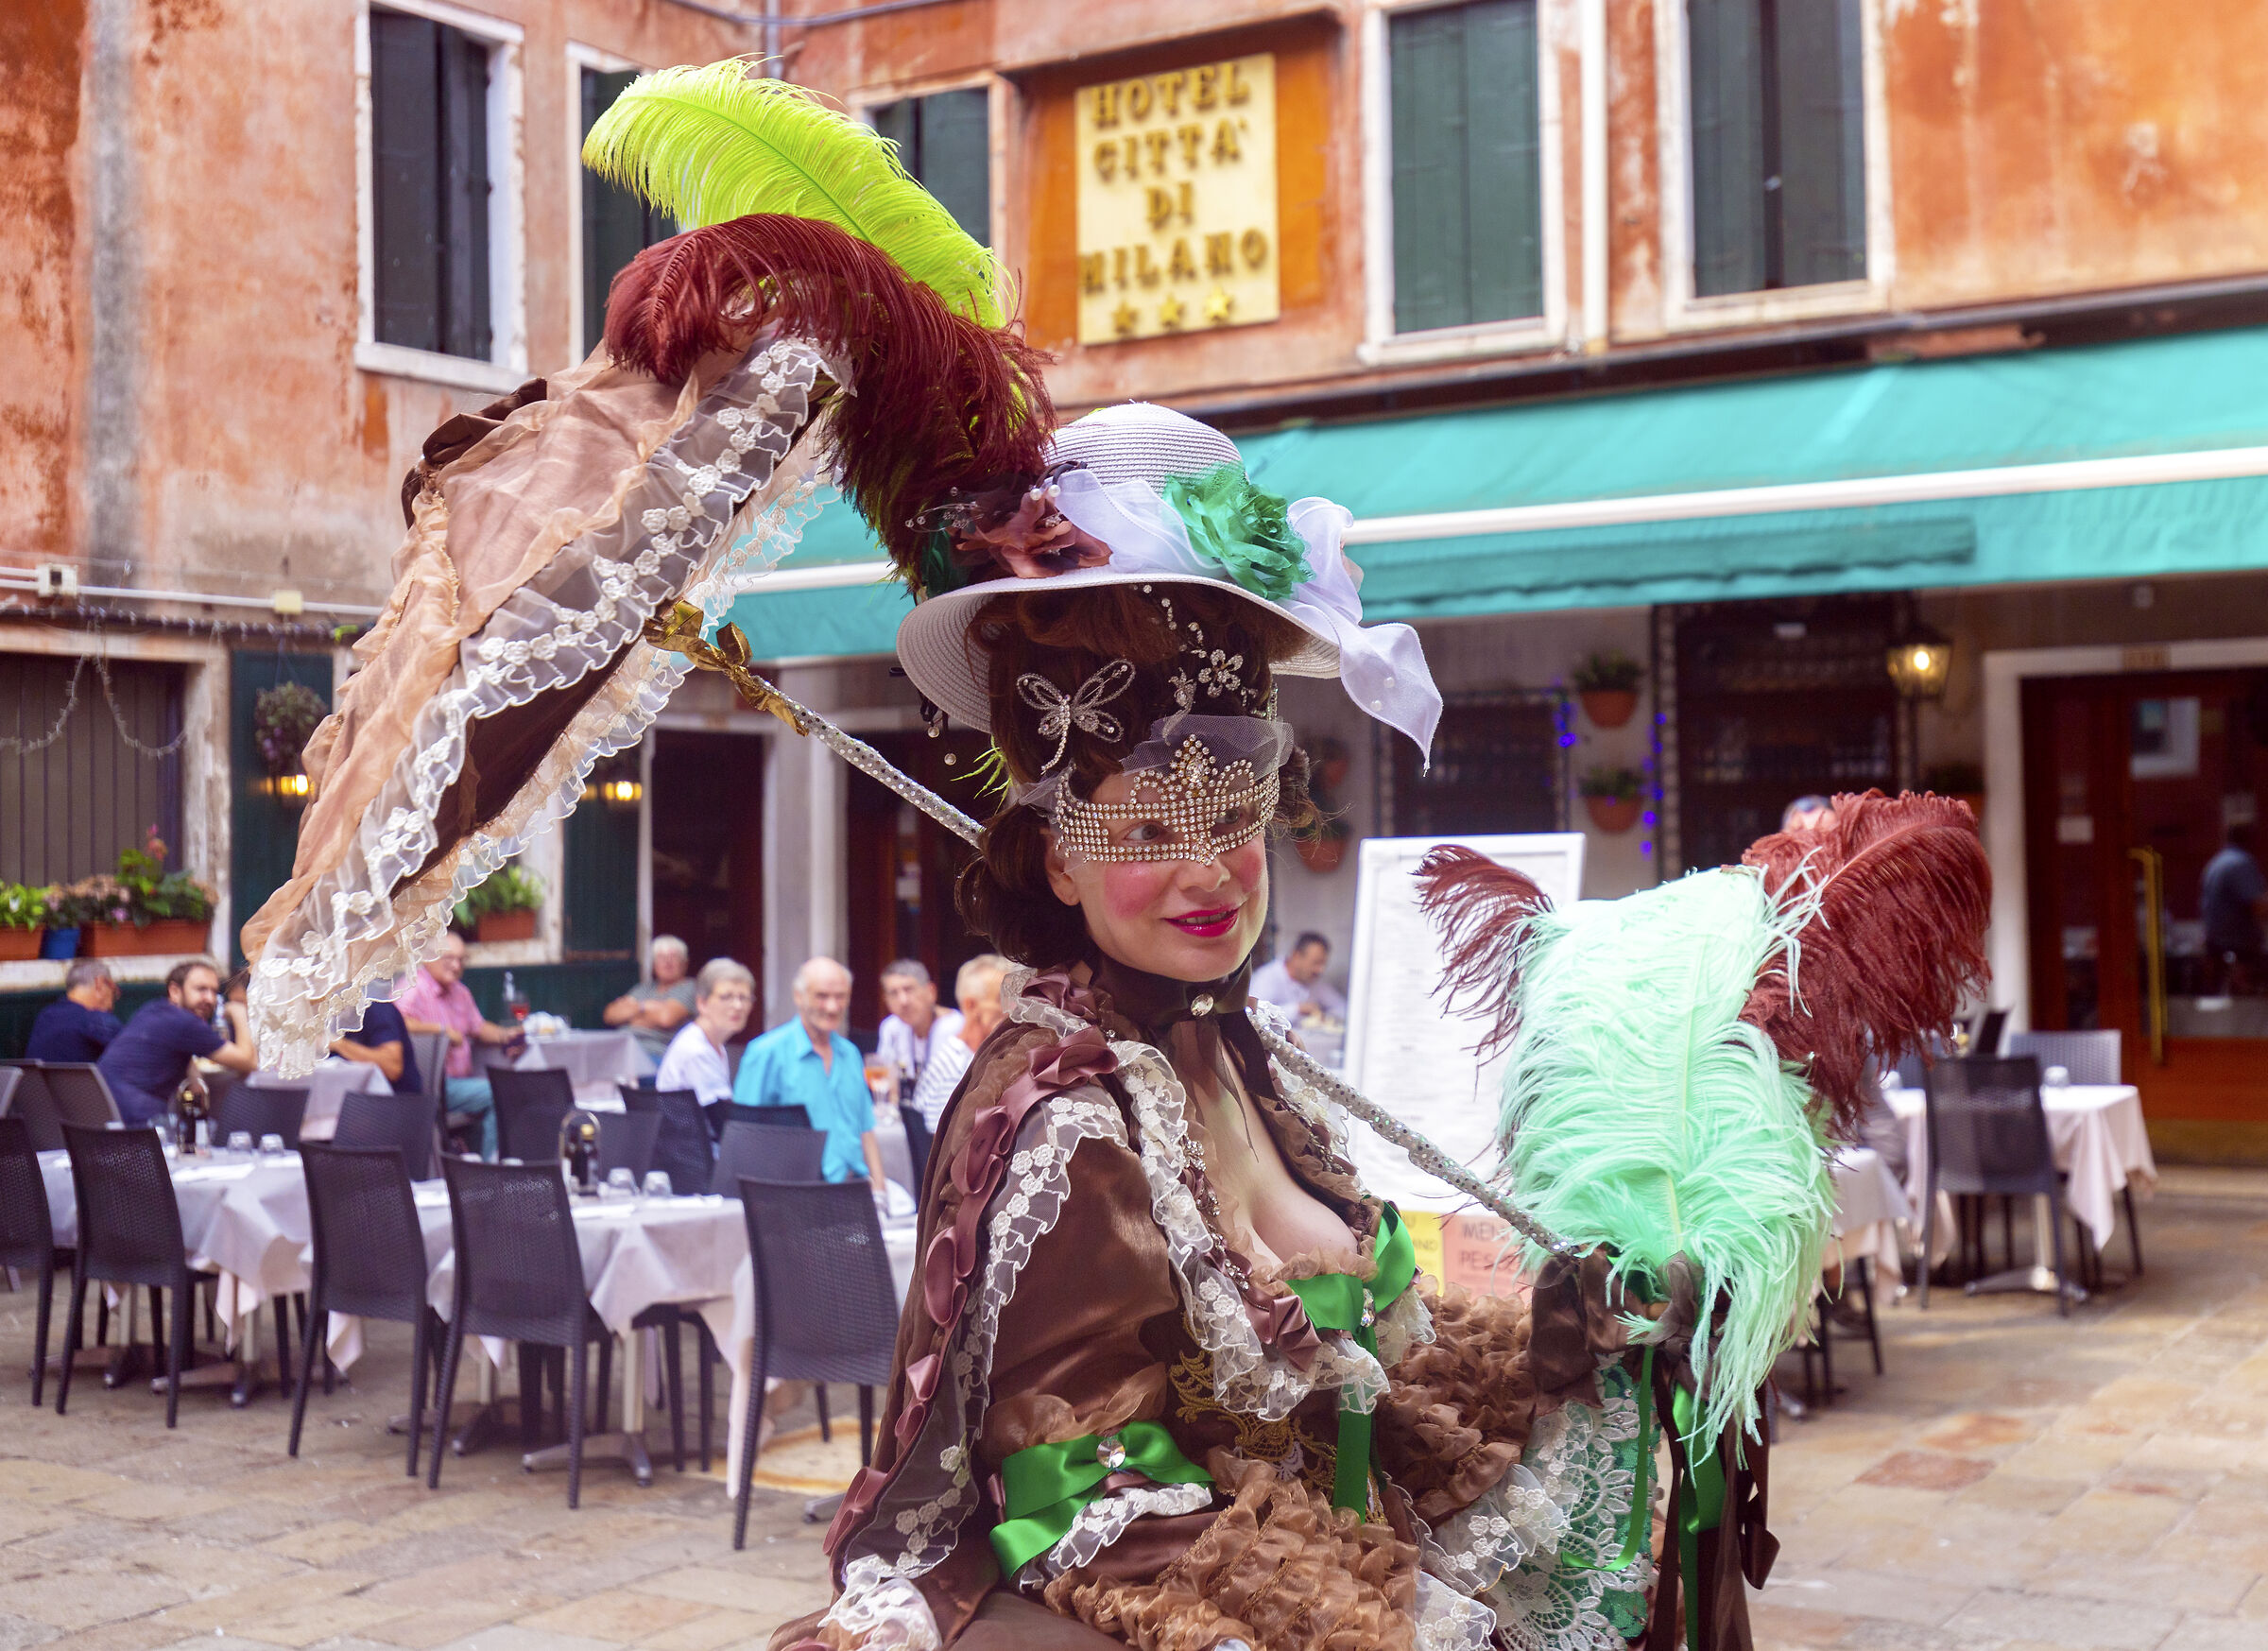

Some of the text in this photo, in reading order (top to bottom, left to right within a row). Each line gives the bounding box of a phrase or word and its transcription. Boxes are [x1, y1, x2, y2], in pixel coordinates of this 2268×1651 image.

[1092, 62, 1250, 129] HOTEL
[1146, 181, 1194, 232] DI
[1079, 229, 1268, 295] MILANO
